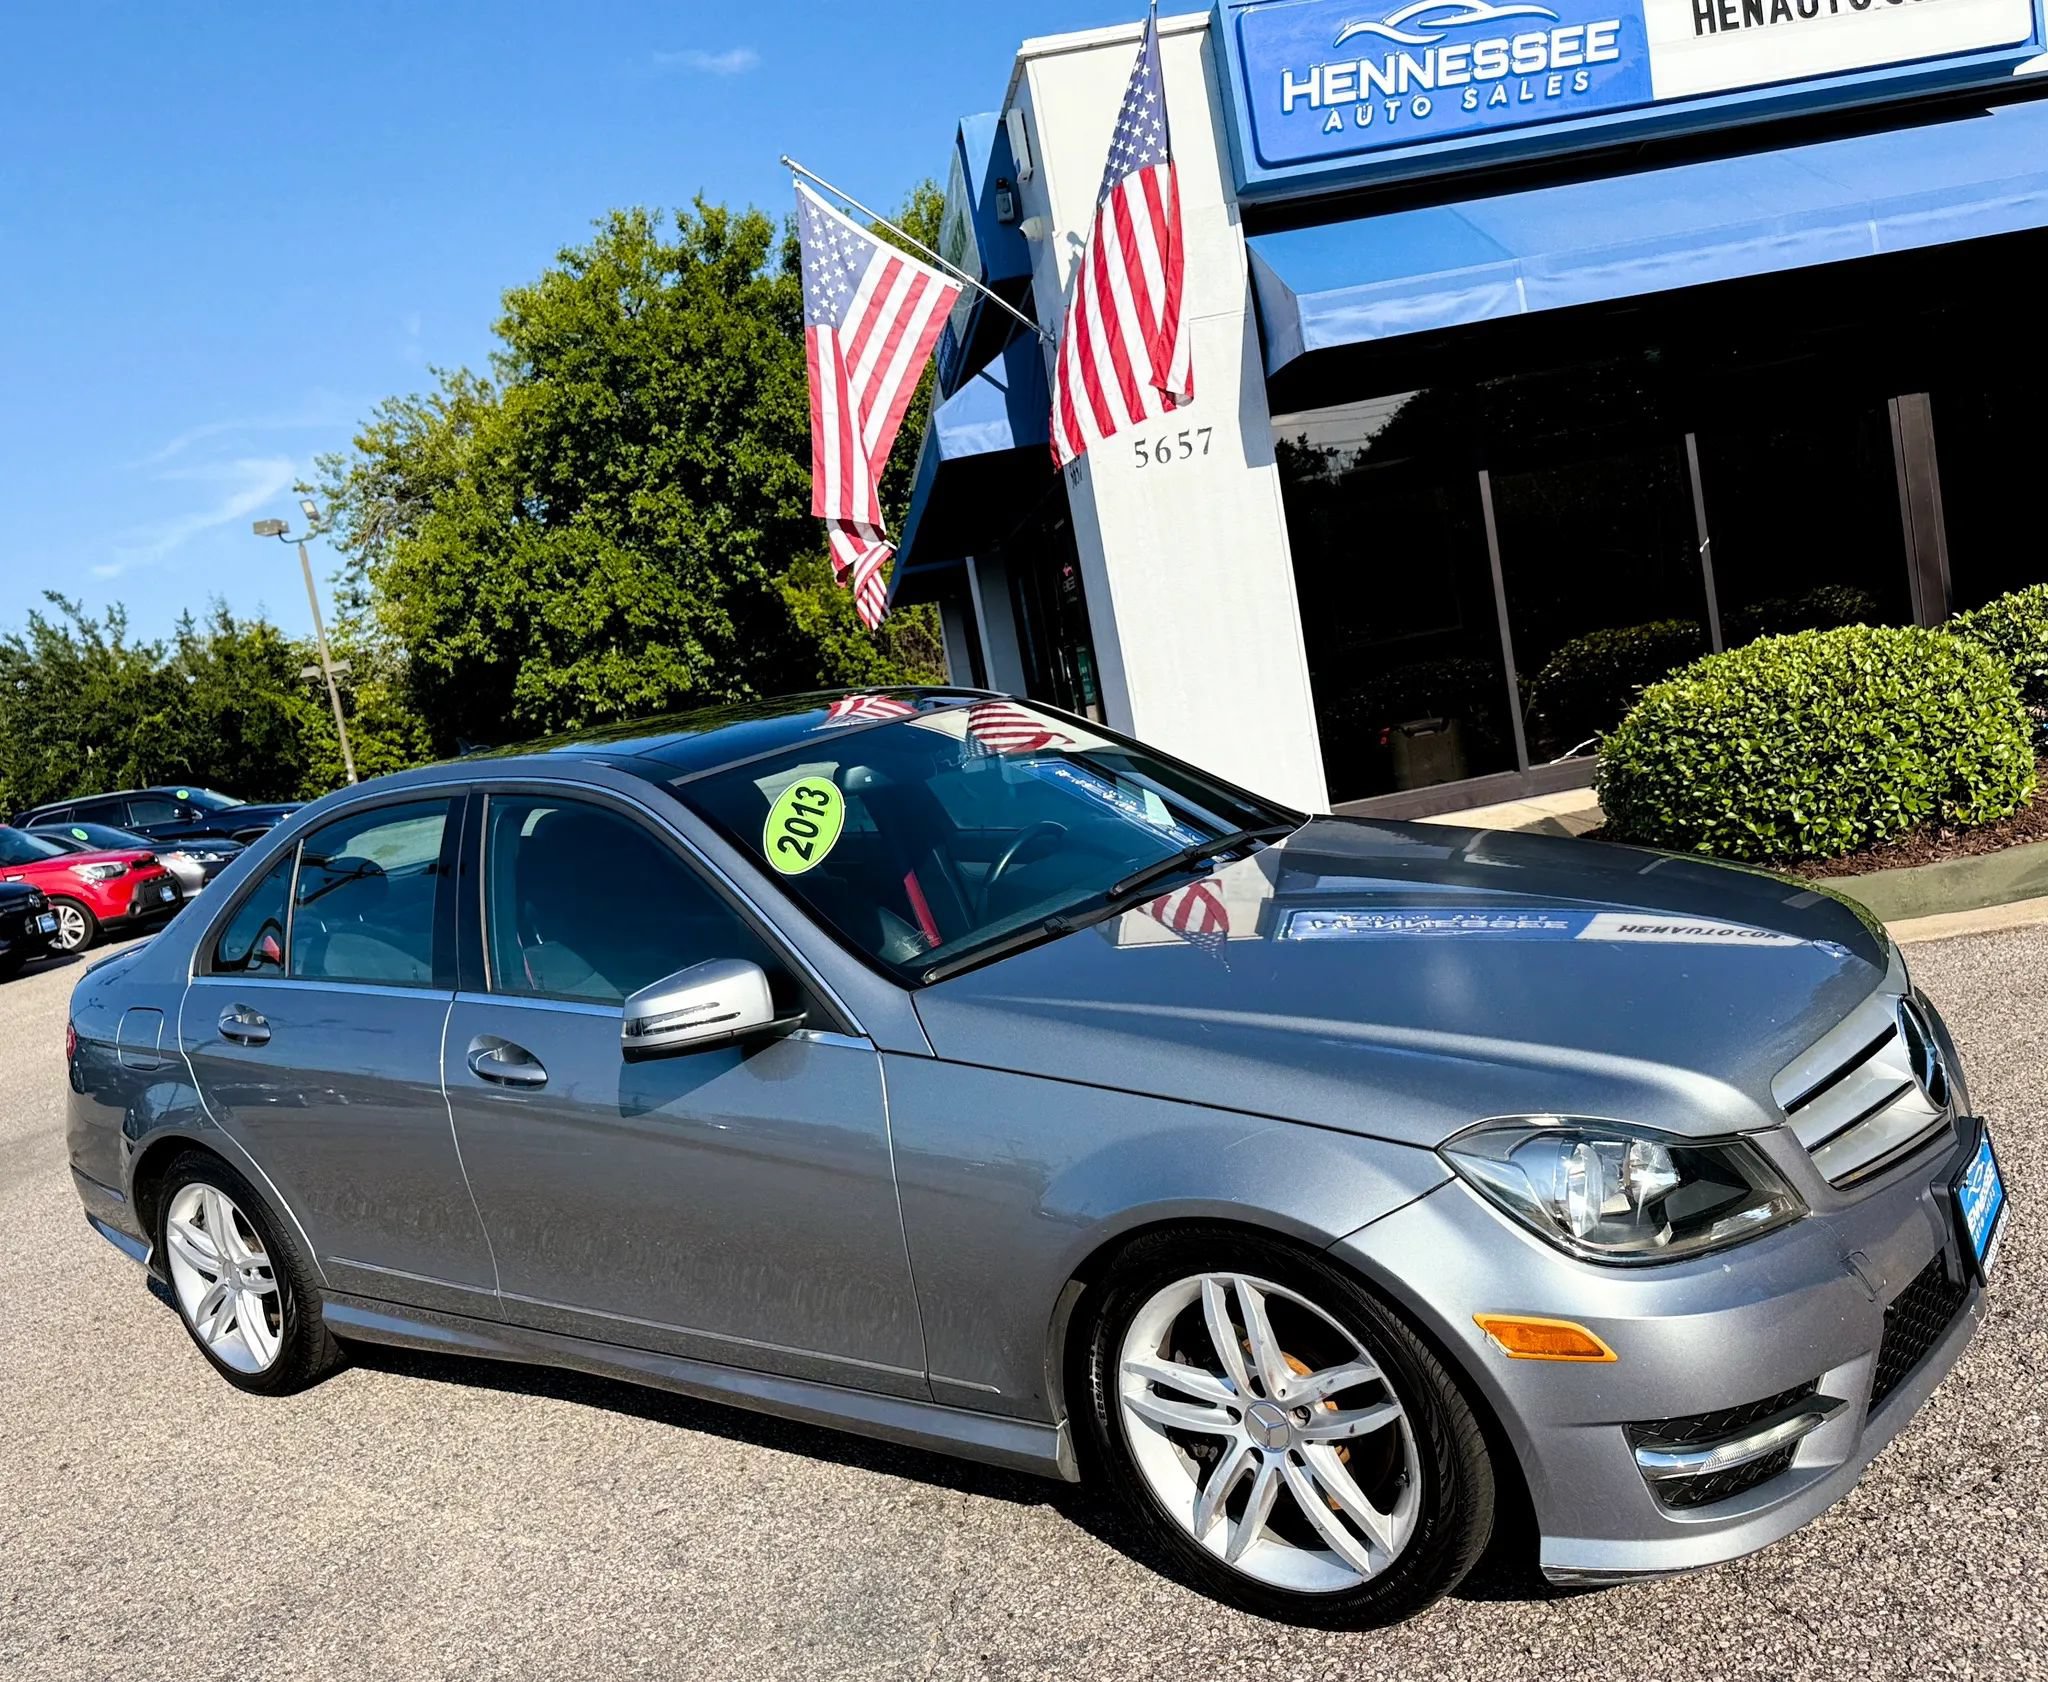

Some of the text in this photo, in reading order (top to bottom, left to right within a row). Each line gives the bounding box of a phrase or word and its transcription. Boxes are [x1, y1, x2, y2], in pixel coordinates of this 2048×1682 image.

[1281, 19, 1622, 113] HENNESSEE
[1323, 70, 1590, 133] AUTO SALES
[1134, 427, 1213, 469] 5657
[777, 786, 830, 862] 2013
